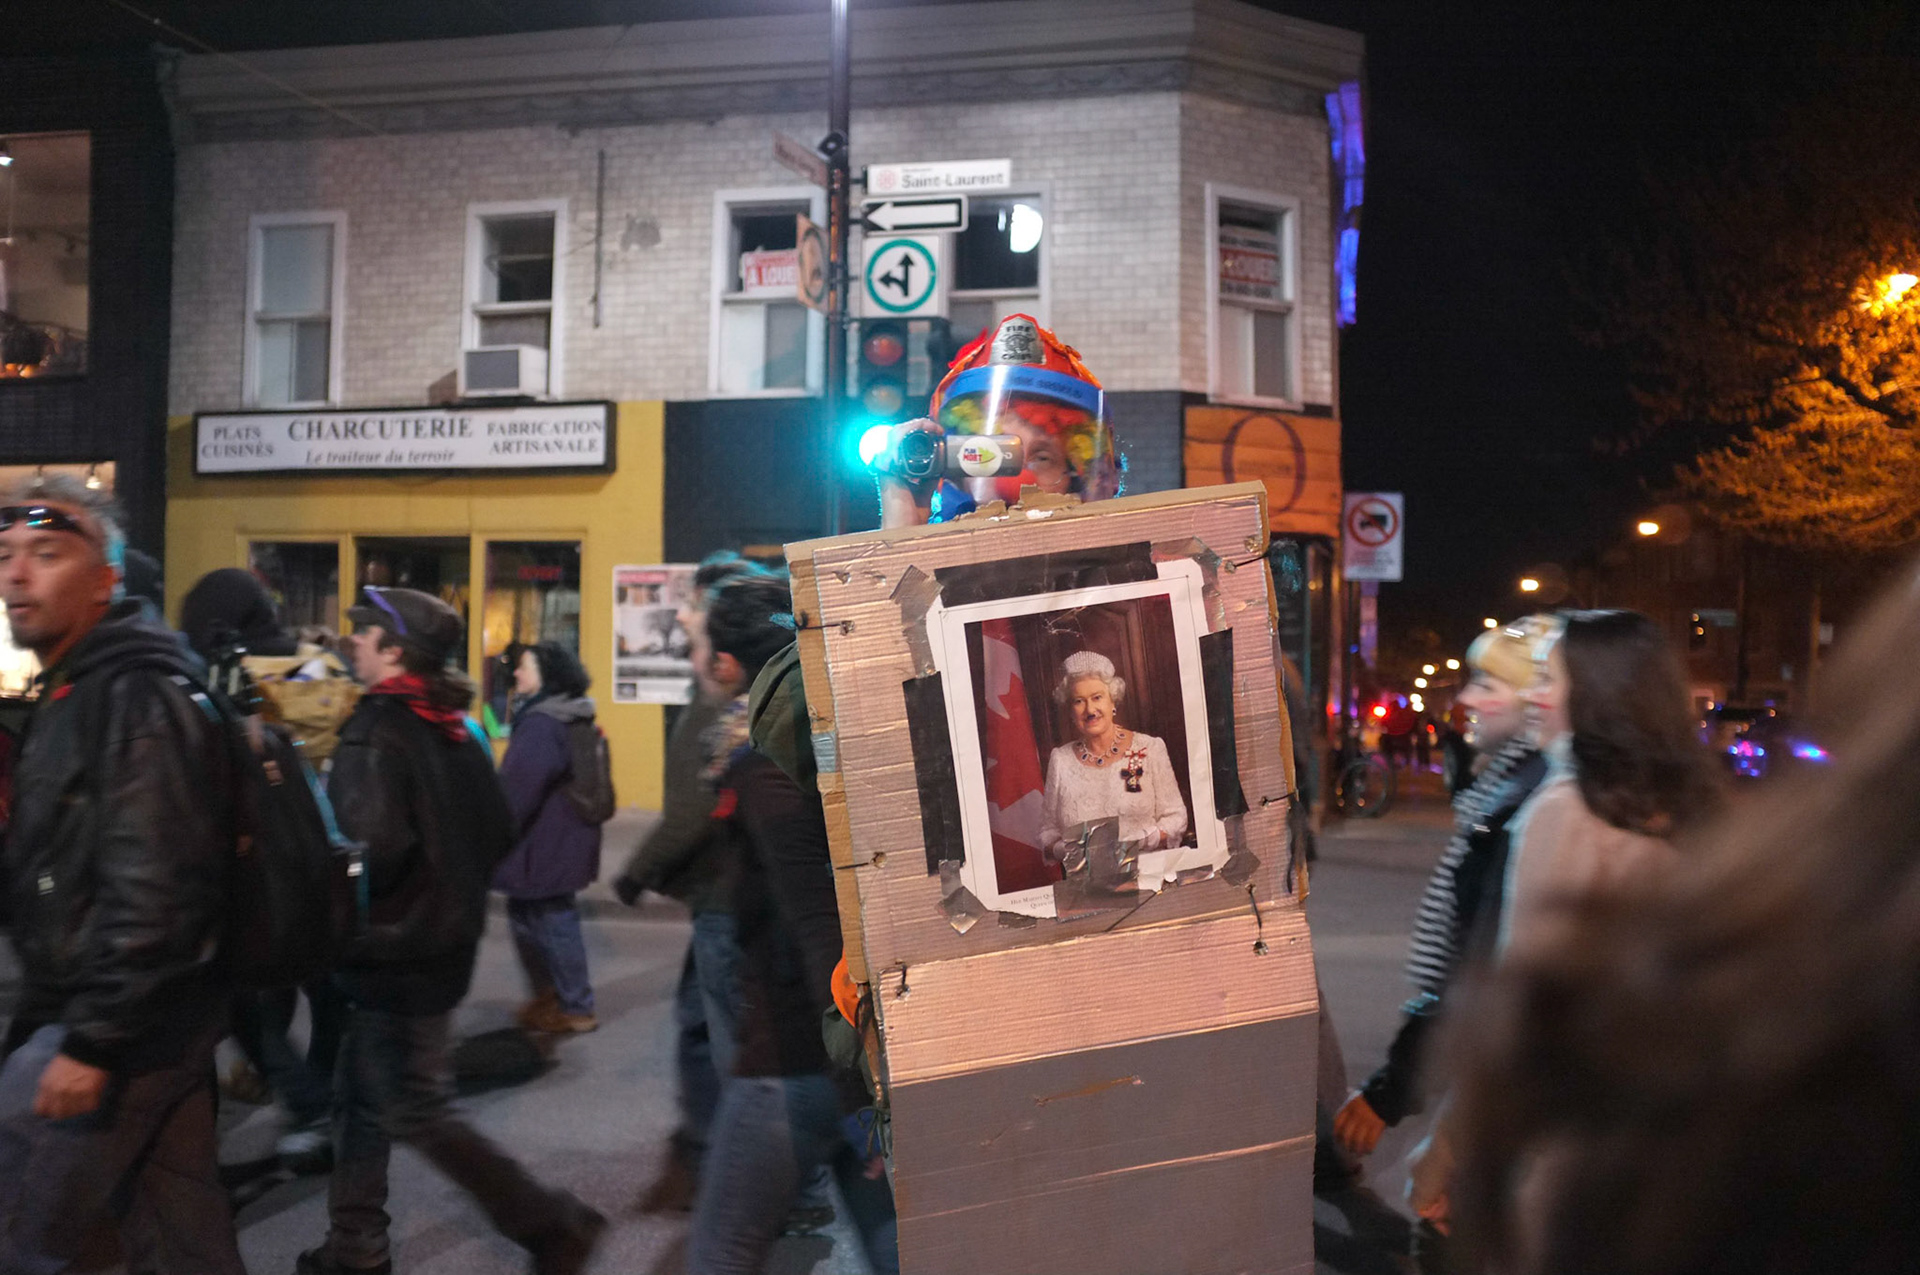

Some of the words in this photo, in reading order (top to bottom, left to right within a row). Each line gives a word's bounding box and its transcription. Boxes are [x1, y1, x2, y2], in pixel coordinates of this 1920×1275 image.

[901, 172, 1004, 188] Saint-Laurent
[762, 264, 797, 285] LOUE
[213, 426, 262, 441] PLATS
[288, 416, 473, 442] CHARCUTERIE
[486, 419, 604, 437] FABRICATION
[489, 438, 600, 455] ARTISANALE
[305, 450, 323, 464] Le
[326, 448, 381, 464] traiteur
[384, 448, 403, 463] du
[407, 447, 455, 463] terroir
